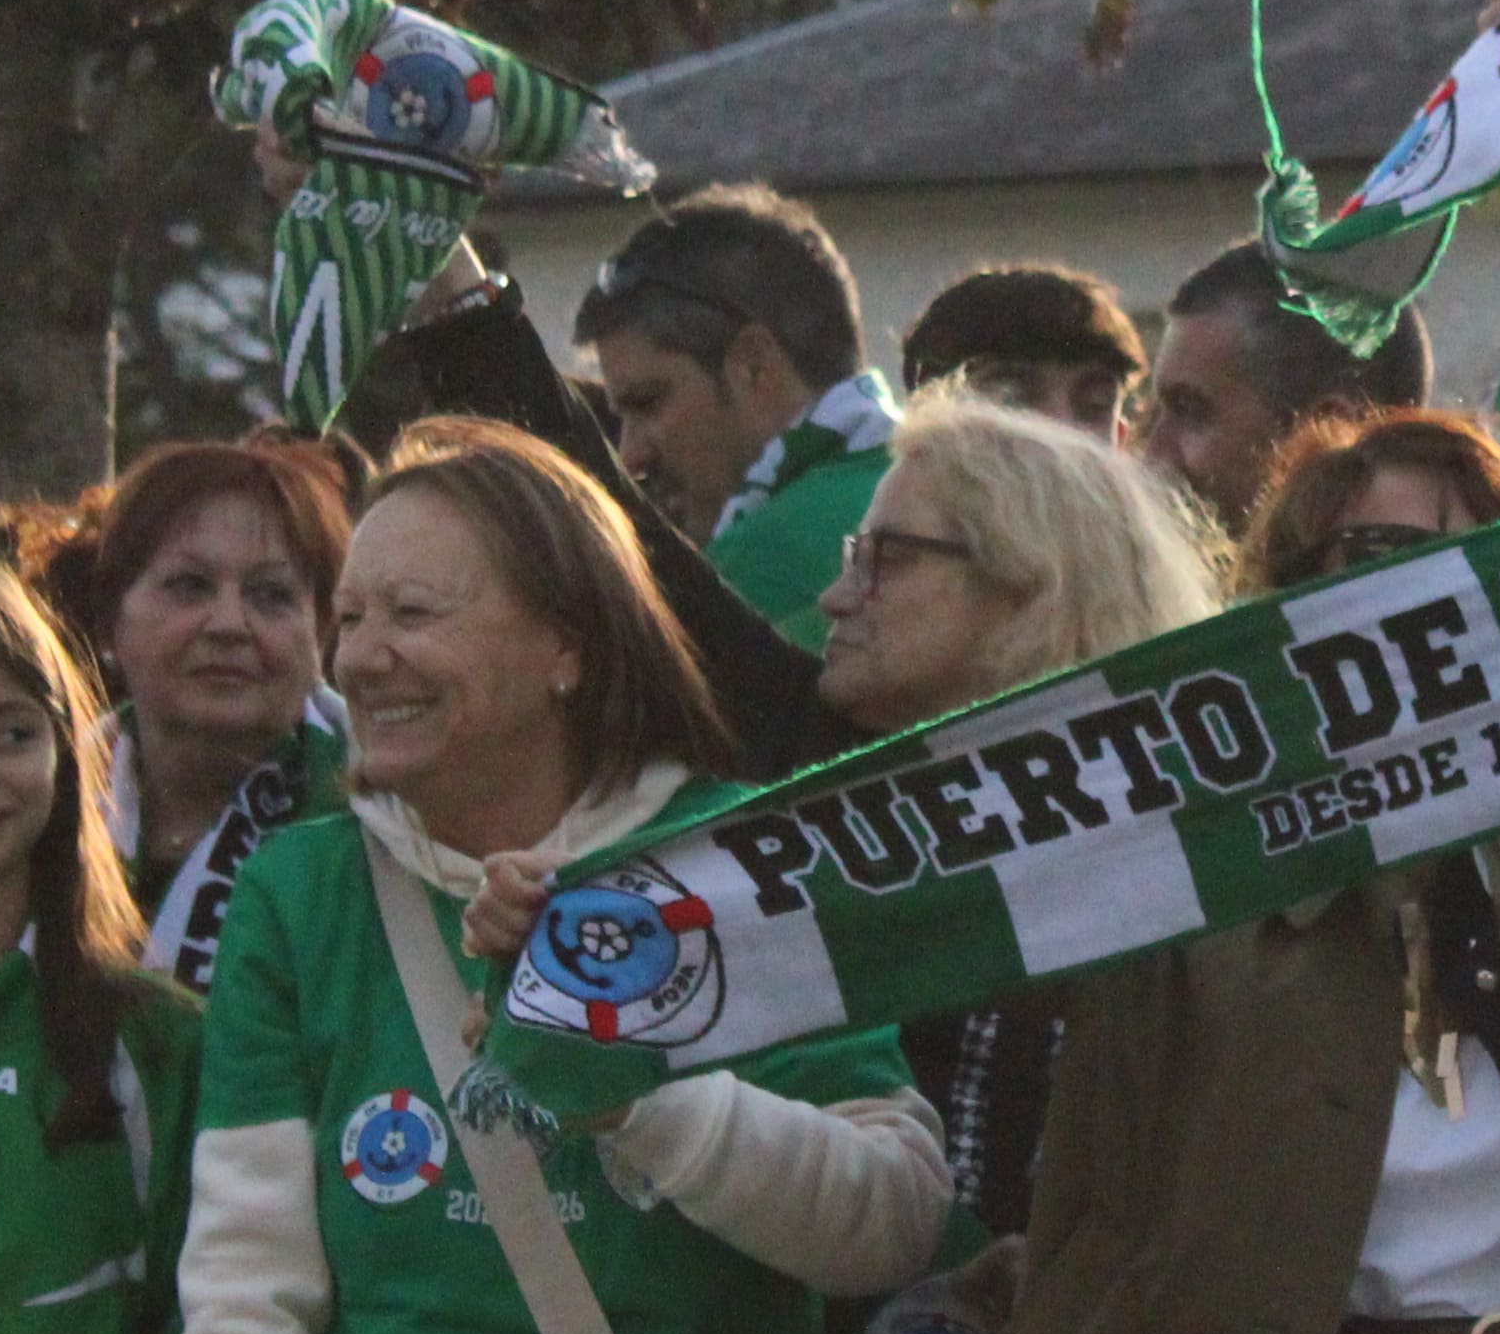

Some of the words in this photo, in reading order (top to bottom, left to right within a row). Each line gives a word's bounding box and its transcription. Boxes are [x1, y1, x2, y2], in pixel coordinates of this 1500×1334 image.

[710, 673, 1277, 917] PUERTO
[1287, 596, 1495, 760] DE
[1249, 736, 1469, 858] DESDE
